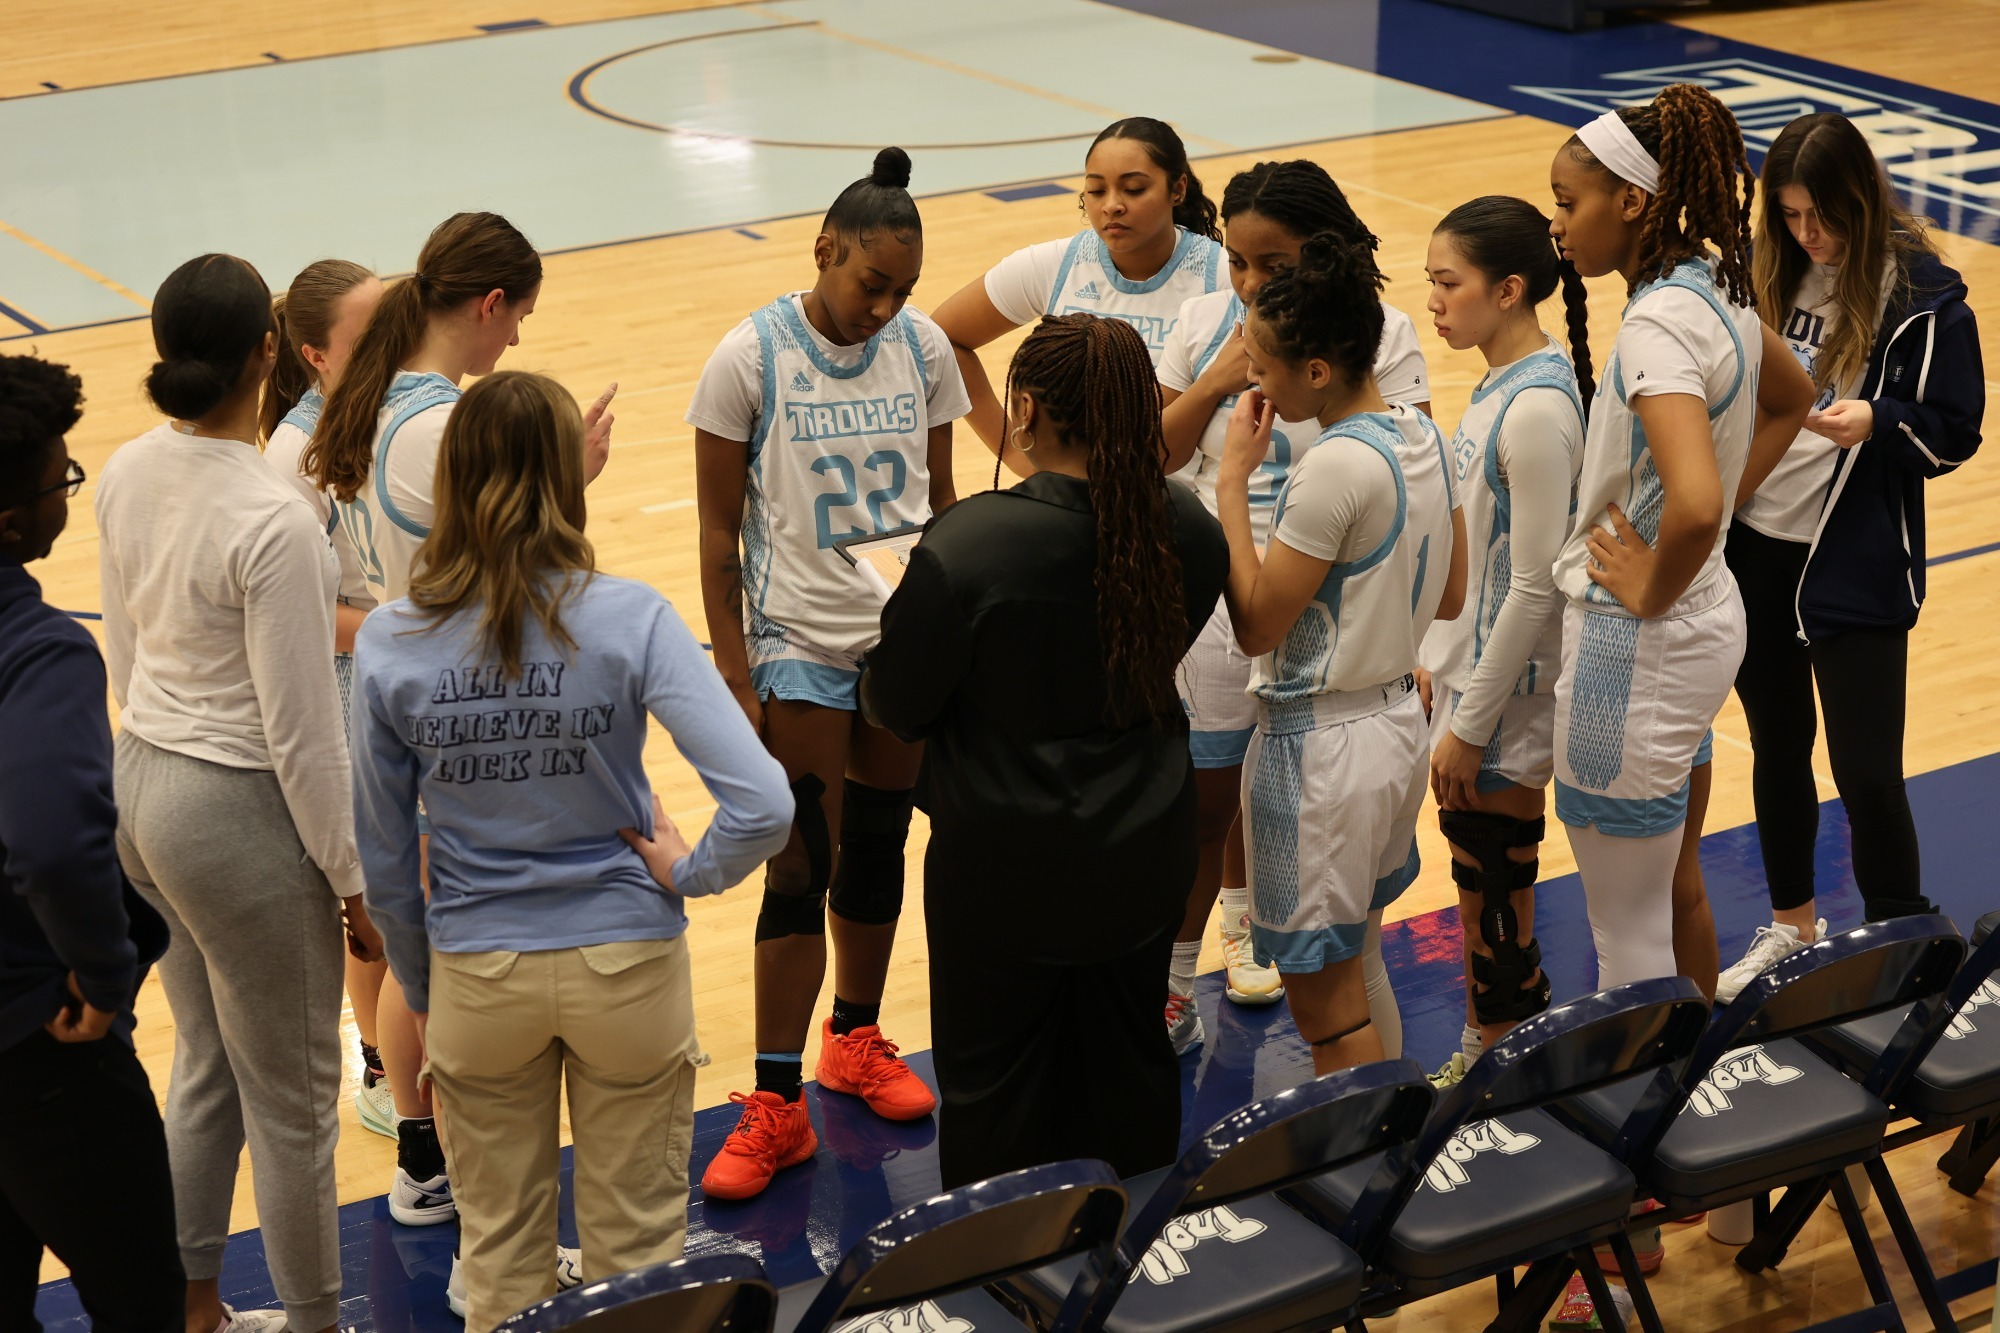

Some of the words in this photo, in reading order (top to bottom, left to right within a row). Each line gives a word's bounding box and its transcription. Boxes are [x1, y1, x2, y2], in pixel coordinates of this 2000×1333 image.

[1074, 291, 1101, 300] adidas
[789, 383, 815, 392] adidas
[784, 392, 917, 442] TROLLS
[810, 450, 914, 549] 22
[432, 664, 506, 704] ALL
[516, 662, 565, 697] IN
[404, 708, 561, 748] BELIEVE
[571, 703, 615, 739] IN
[432, 750, 531, 784] LOCK
[540, 746, 587, 777] IN
[1679, 1044, 1805, 1117] Troll
[1415, 1118, 1541, 1193] Troll
[1127, 1205, 1268, 1285] Troll
